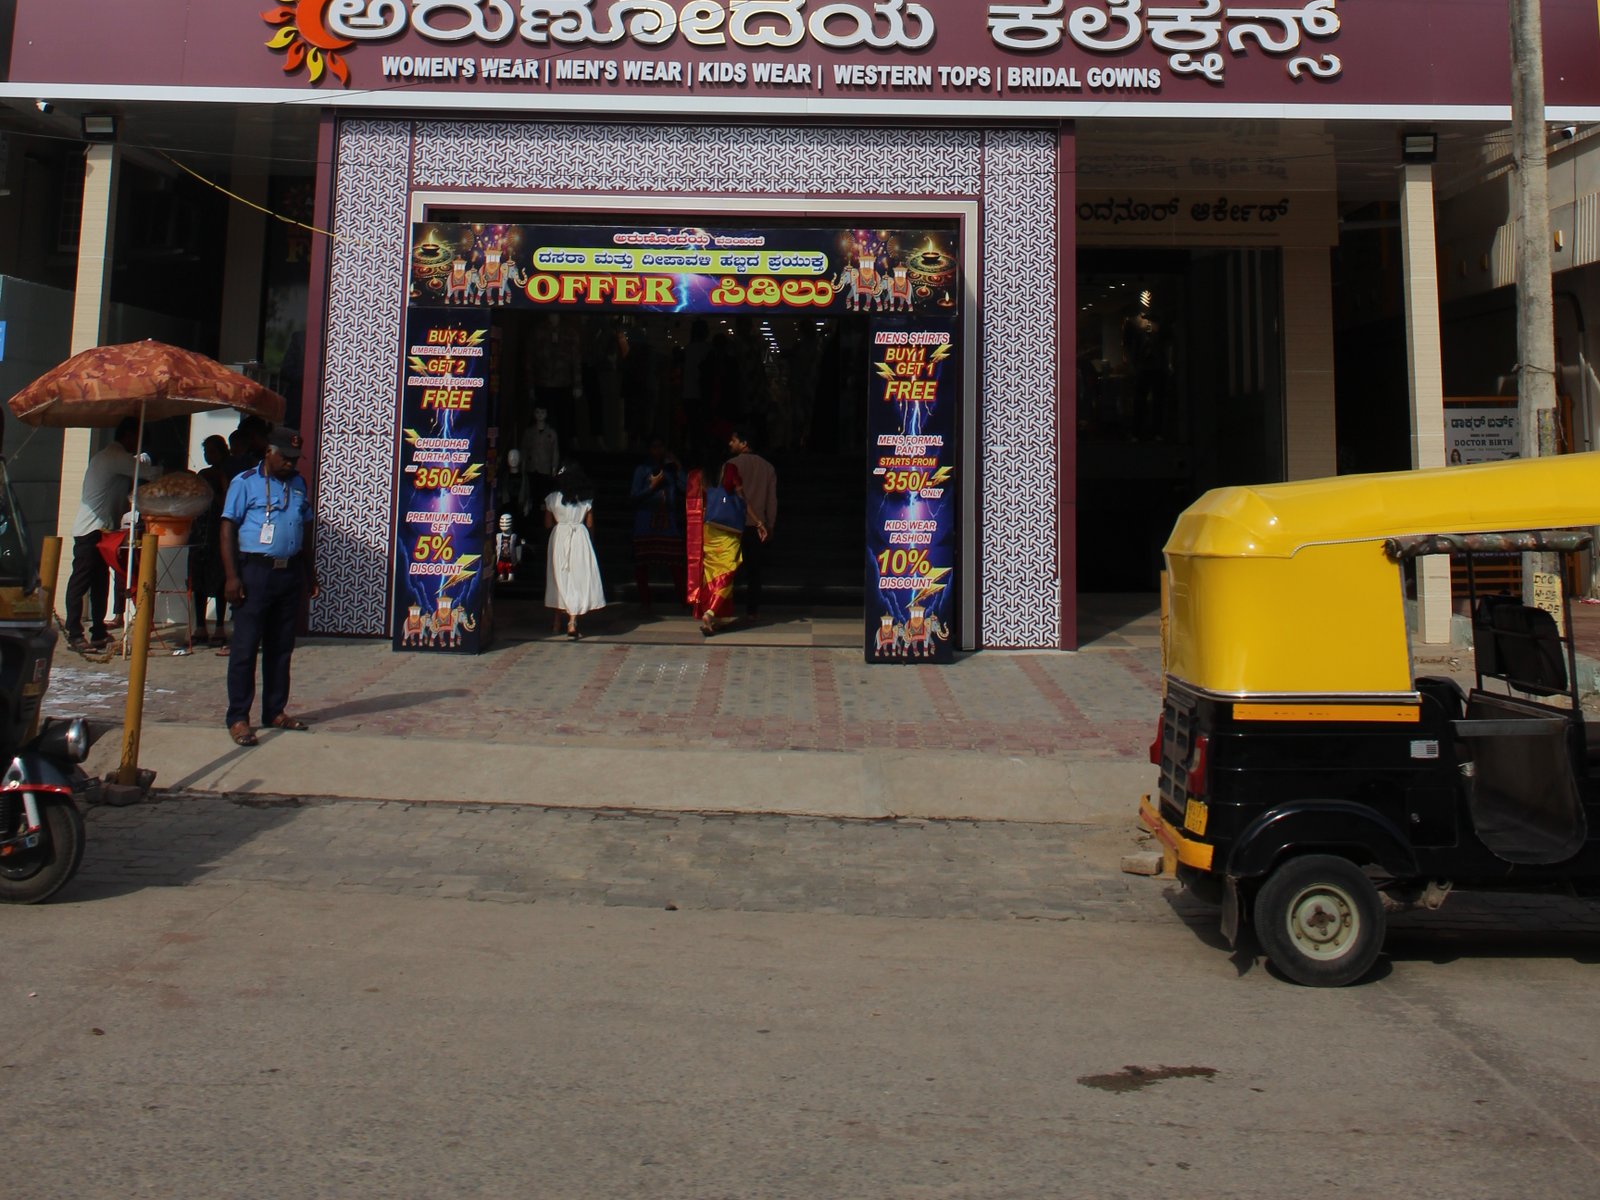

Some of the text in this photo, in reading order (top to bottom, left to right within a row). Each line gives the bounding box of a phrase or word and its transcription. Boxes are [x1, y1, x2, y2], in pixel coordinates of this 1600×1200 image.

[382, 56, 475, 78] WOMEN'S
[481, 57, 538, 79] WEAR
[556, 61, 617, 81] MEN'S
[623, 61, 682, 82] WEAR
[698, 62, 746, 83] KIDS
[753, 63, 811, 83] WEAR
[834, 65, 932, 86] WESTERN
[938, 67, 991, 87] TOPS
[1007, 67, 1081, 87] BRIDAL
[1087, 67, 1161, 88] GOWNS
[613, 232, 710, 246] ಅರುಣೋದಯ
[538, 251, 824, 273] ದಸರಾ ಮತ್ತು ದೀಪಾವಳಿ ಹಬ್ಬದ ಪ್ರಯುಕ್ತ
[526, 275, 833, 305] OFFER ಸಿಡಿಲು
[428, 330, 468, 344] BUY 3
[875, 332, 949, 345] MENS SHIRTS
[411, 346, 483, 356] UMBRELLA KURTHA
[885, 348, 925, 361] BUY 1
[428, 359, 466, 373] GET 2
[895, 362, 934, 376] GET 1
[408, 377, 484, 386] BRANDED LEGGINGS
[885, 381, 937, 400] FREE
[421, 390, 473, 409] FREE
[415, 438, 469, 449] CHUDIDHAR
[878, 435, 943, 445] MENS FORMAL
[1454, 439, 1487, 447] DOCTOR
[895, 445, 926, 455] PANTS
[413, 452, 470, 462] KURTHA SET
[879, 457, 936, 466] STARTS FROM
[451, 485, 474, 495] ONLY
[920, 488, 944, 498] ONLY
[406, 512, 473, 523] PREMIUM FULL
[431, 523, 449, 532] SET
[884, 520, 936, 531] KIDS WEAR
[890, 533, 932, 543] FASHION
[414, 535, 453, 561] 5%
[878, 549, 931, 575] 10%
[409, 563, 463, 575] DISCOUNT
[879, 577, 933, 588] DISCOUNT
